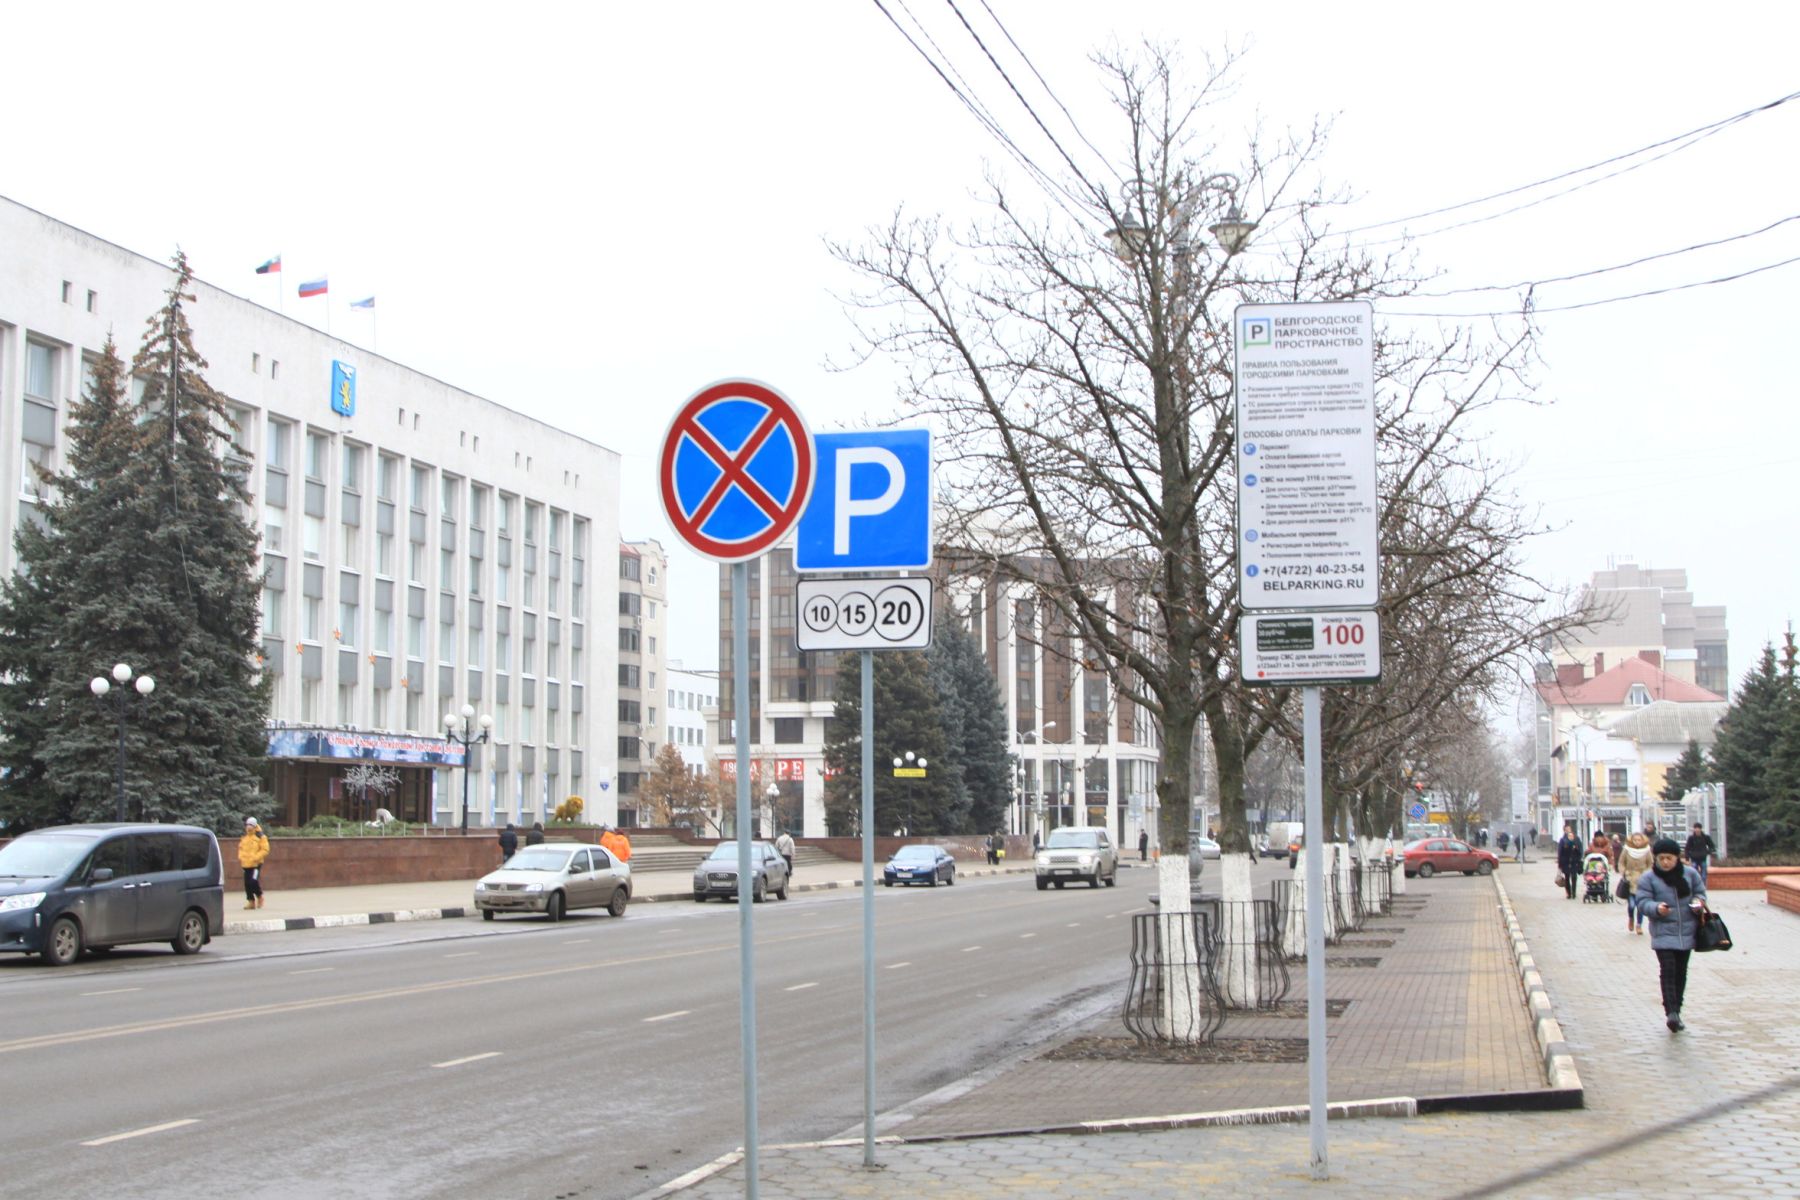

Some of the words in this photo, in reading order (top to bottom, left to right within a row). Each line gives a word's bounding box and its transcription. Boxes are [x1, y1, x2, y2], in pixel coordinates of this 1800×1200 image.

[1275, 315, 1364, 326] БЕЛГОРОДСКОЕ
[1275, 326, 1358, 338] ПАРКОВОЧНОЕ
[1275, 337, 1364, 349] ПРОСТРАНСТВО
[1242, 361, 1278, 369] ПРАВИЛА
[1280, 358, 1338, 368] ПОЛЬЗОВАНИЯ
[1242, 370, 1294, 380] ГОРОДСКИМИ
[1296, 368, 1349, 378] ПАРКОВКАМИ
[1243, 431, 1282, 439] СПОСОБЫ
[1285, 429, 1318, 438] ОПЛАТЫ
[1320, 428, 1361, 437] ПАРКОВКИ
[1264, 565, 1312, 577] +7(4722)
[1316, 564, 1365, 574] 40-23-54
[1263, 579, 1364, 591] BELPARKING.RU
[811, 606, 830, 622] 10
[843, 605, 866, 624] 15
[882, 601, 911, 625] 20
[1322, 624, 1364, 645] 100
